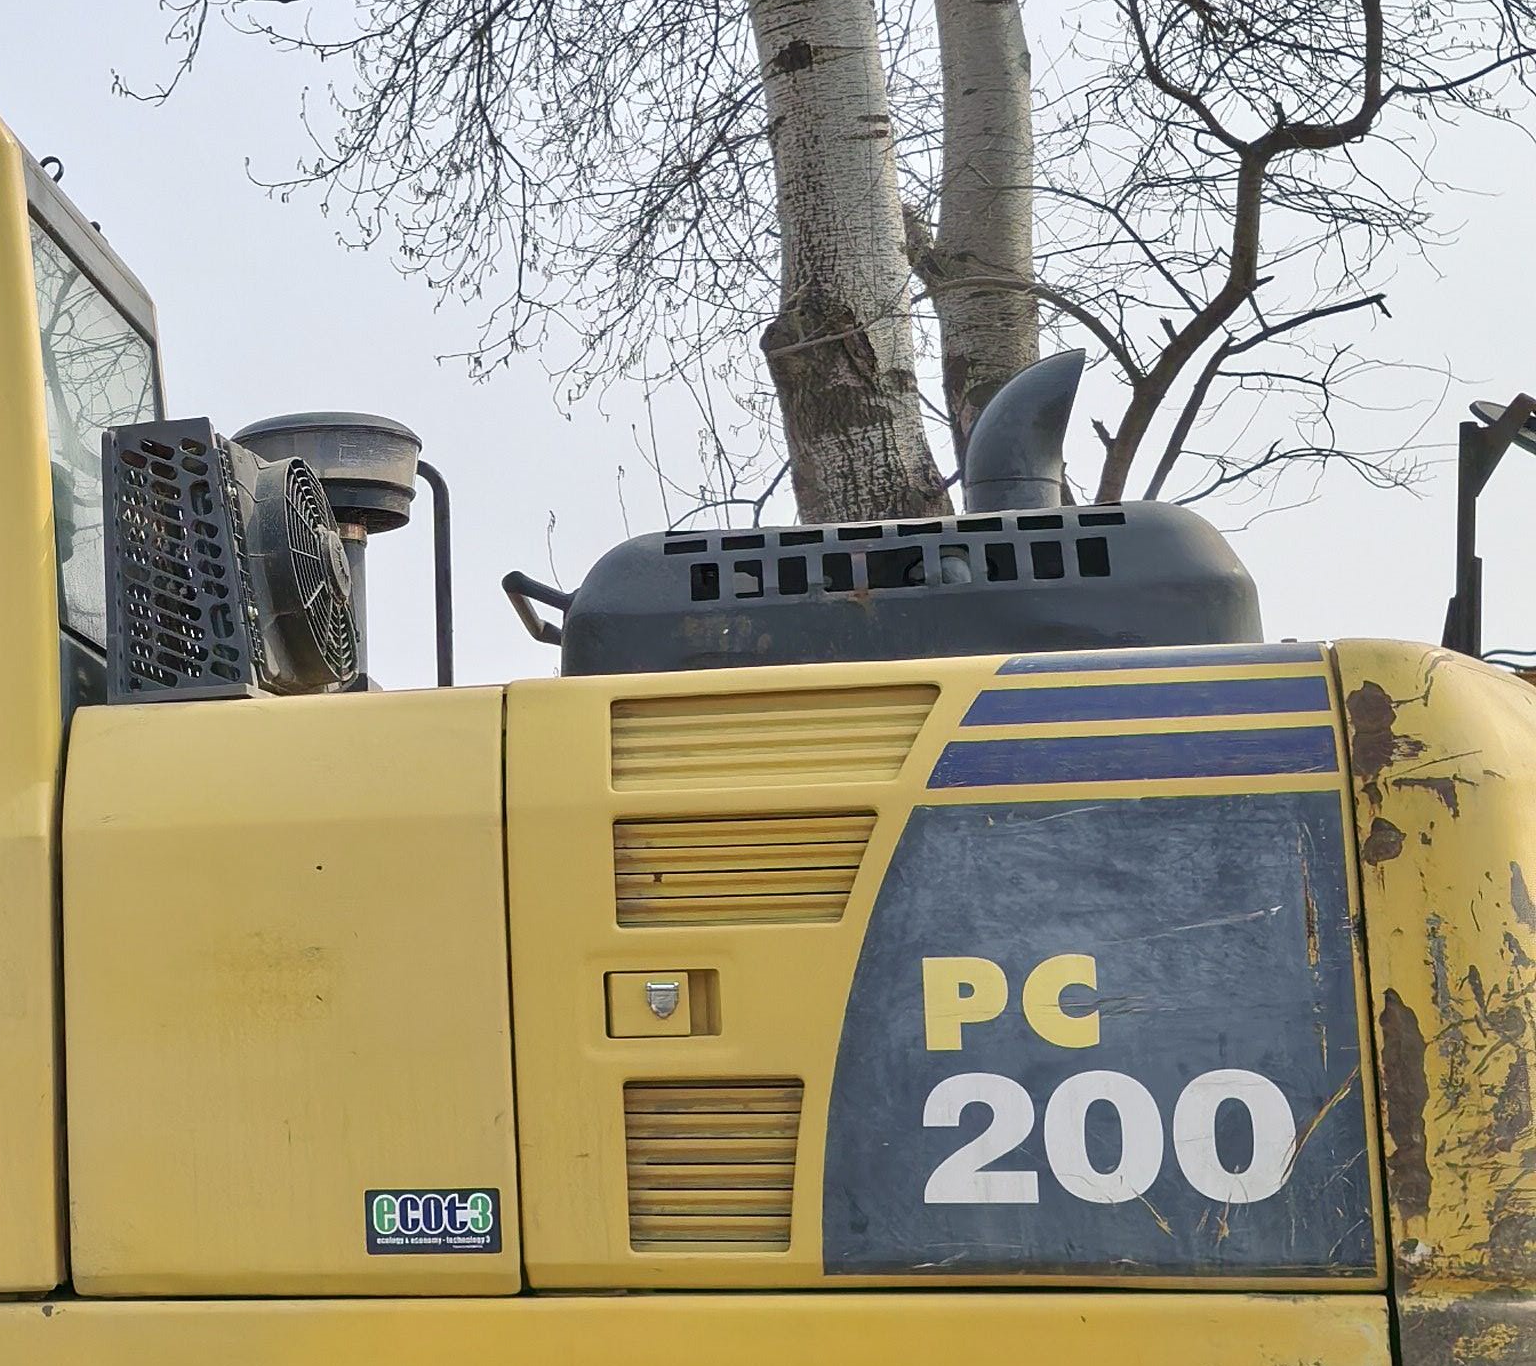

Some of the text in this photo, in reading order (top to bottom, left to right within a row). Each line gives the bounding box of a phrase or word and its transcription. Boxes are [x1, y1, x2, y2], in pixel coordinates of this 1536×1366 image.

[921, 953, 1101, 1051] PC
[921, 1068, 1297, 1205] 200
[373, 1192, 494, 1235] ecot3
